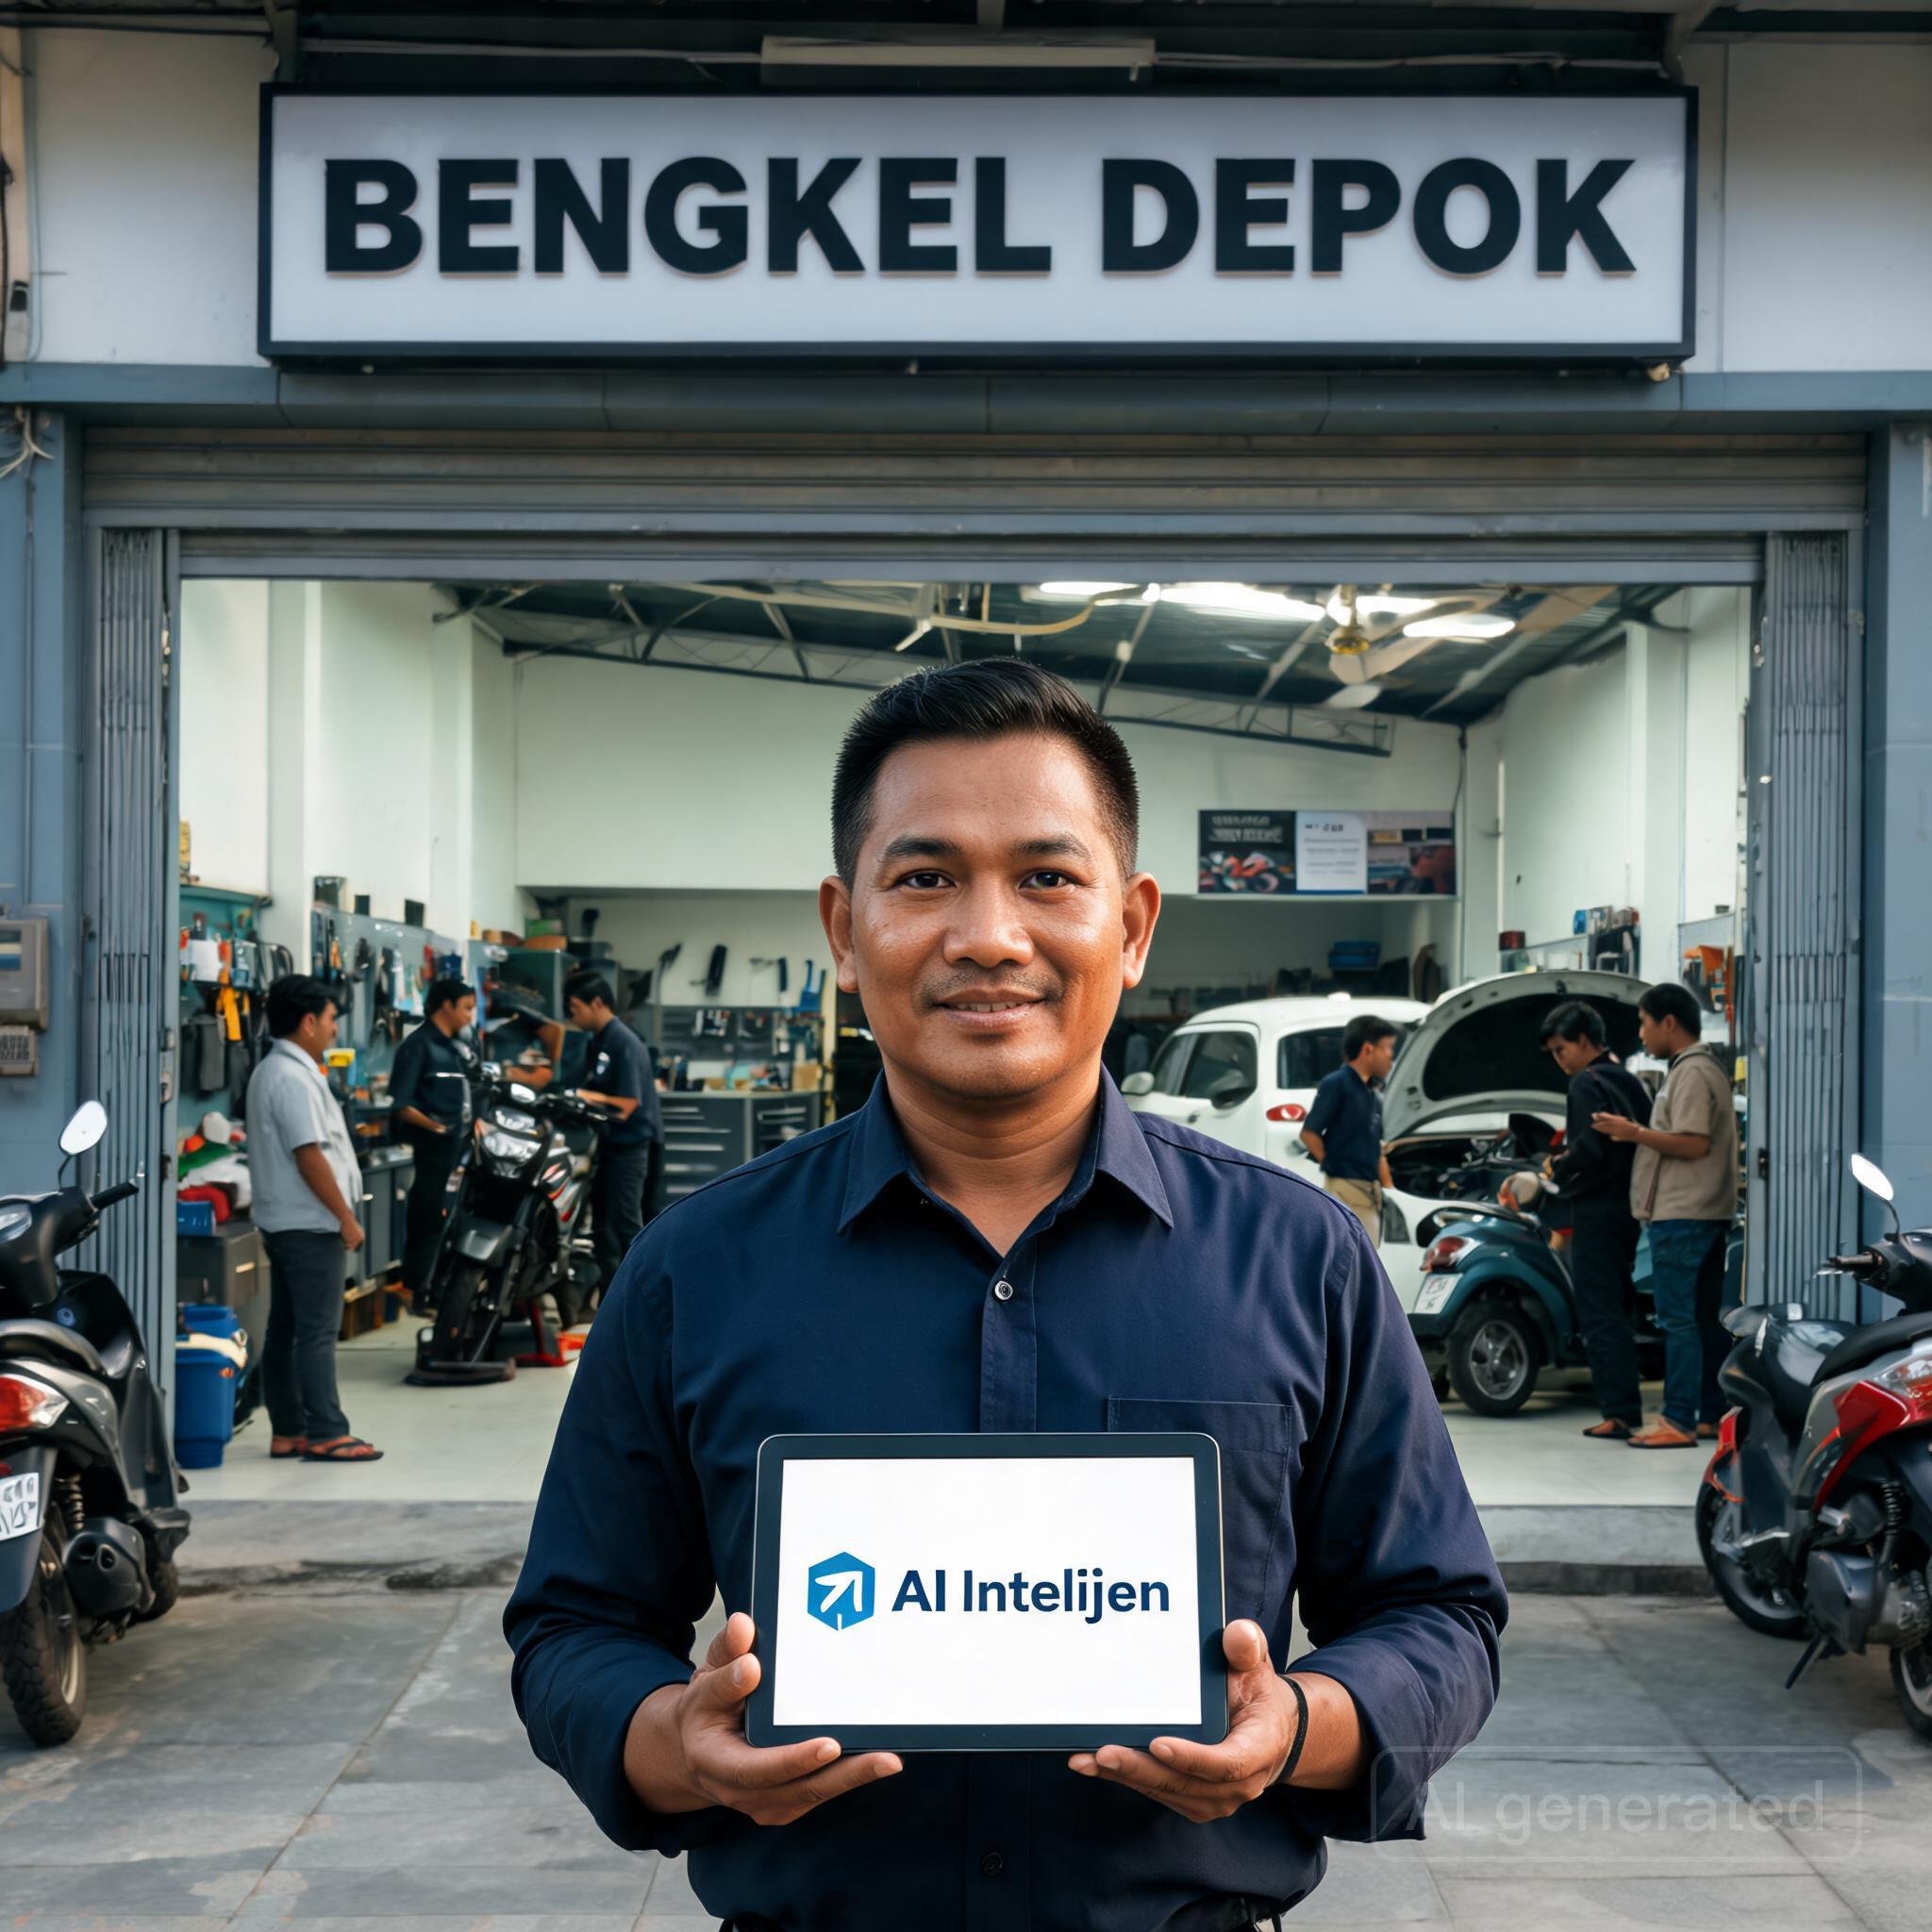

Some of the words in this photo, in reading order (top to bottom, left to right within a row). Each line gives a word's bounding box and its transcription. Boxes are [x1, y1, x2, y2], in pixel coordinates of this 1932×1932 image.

[325, 157, 1052, 274] BENGKEL
[1103, 158, 1637, 275] DEPOK
[891, 1570, 946, 1612] AI
[963, 1568, 1170, 1624] Intelijen
